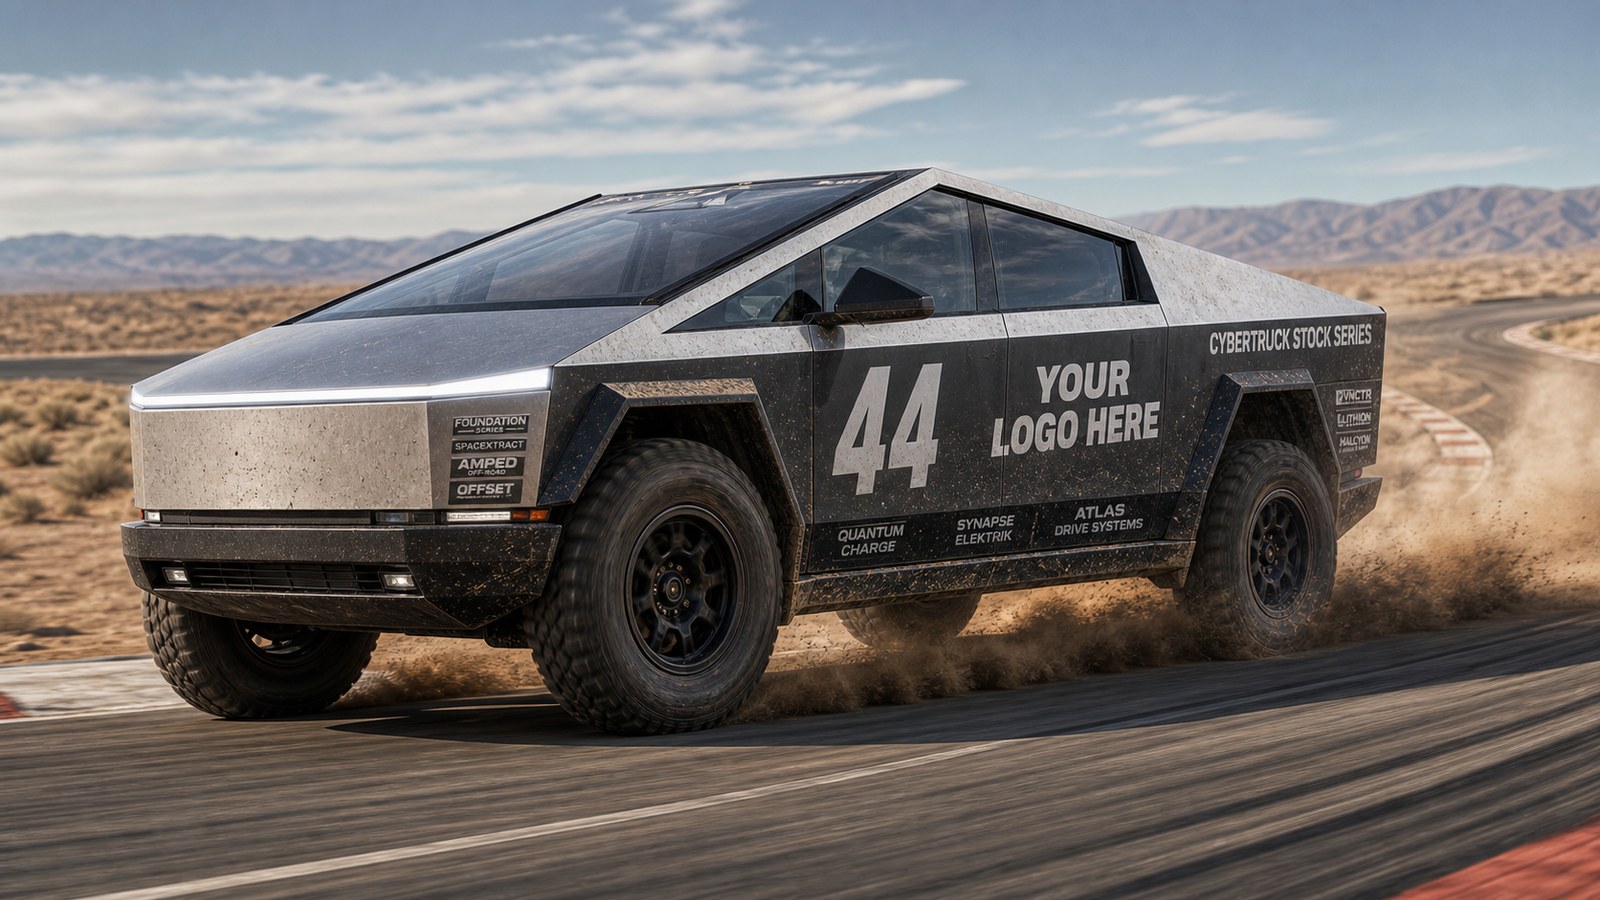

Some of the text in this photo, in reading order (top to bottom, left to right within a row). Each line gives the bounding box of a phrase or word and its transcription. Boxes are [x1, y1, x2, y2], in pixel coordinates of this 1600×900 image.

[1209, 323, 1372, 355] CYBERTRUCK STOCK SERIES
[1036, 359, 1131, 404] YOUR
[454, 416, 527, 428] FOUNDATION
[832, 362, 943, 496] 44
[991, 401, 1161, 458] LOGO HERE
[454, 440, 524, 451] SPACEXTRACT
[457, 457, 518, 470] AMPED
[456, 483, 515, 495] OFFSET
[1074, 503, 1126, 521] ATLAS
[956, 514, 1015, 532] SYNAPSE
[1054, 518, 1144, 537] DRIVE SYSTEMS
[837, 524, 905, 543] QUANTUM
[955, 530, 1013, 547] ELEKTRIK
[841, 540, 897, 557] CHARGE
